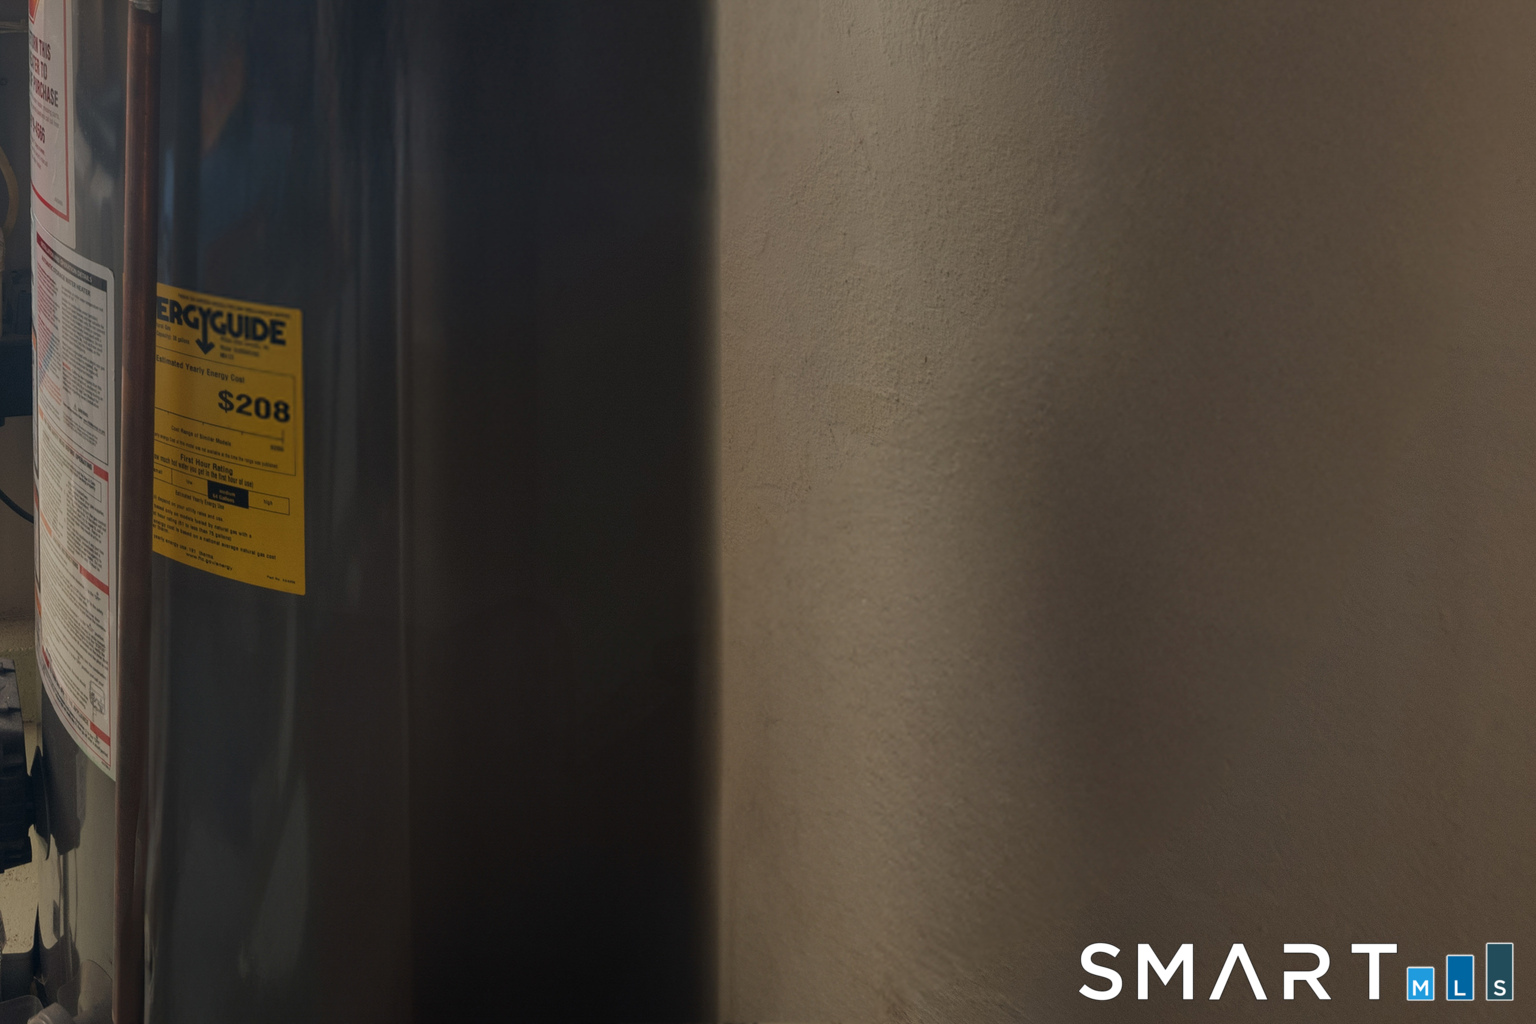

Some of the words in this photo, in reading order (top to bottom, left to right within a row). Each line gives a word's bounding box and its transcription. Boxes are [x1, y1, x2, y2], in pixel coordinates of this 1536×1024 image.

[39, 39, 51, 61] THIS
[41, 61, 48, 80] TO
[33, 76, 59, 108] PURCHASE
[157, 296, 287, 346] ERGYGUIDE
[156, 354, 183, 369] Estimated
[185, 362, 204, 375] Yearly
[206, 368, 228, 381] Energy
[230, 373, 244, 383] Cost
[218, 390, 291, 423] $208
[215, 438, 231, 446] Models
[180, 453, 193, 463] First
[195, 457, 210, 468] Hour
[212, 462, 232, 475] Rating
[227, 475, 237, 484] hour
[214, 524, 228, 533] natural
[203, 536, 219, 546] national
[221, 542, 238, 552] average
[240, 547, 255, 555] natural
